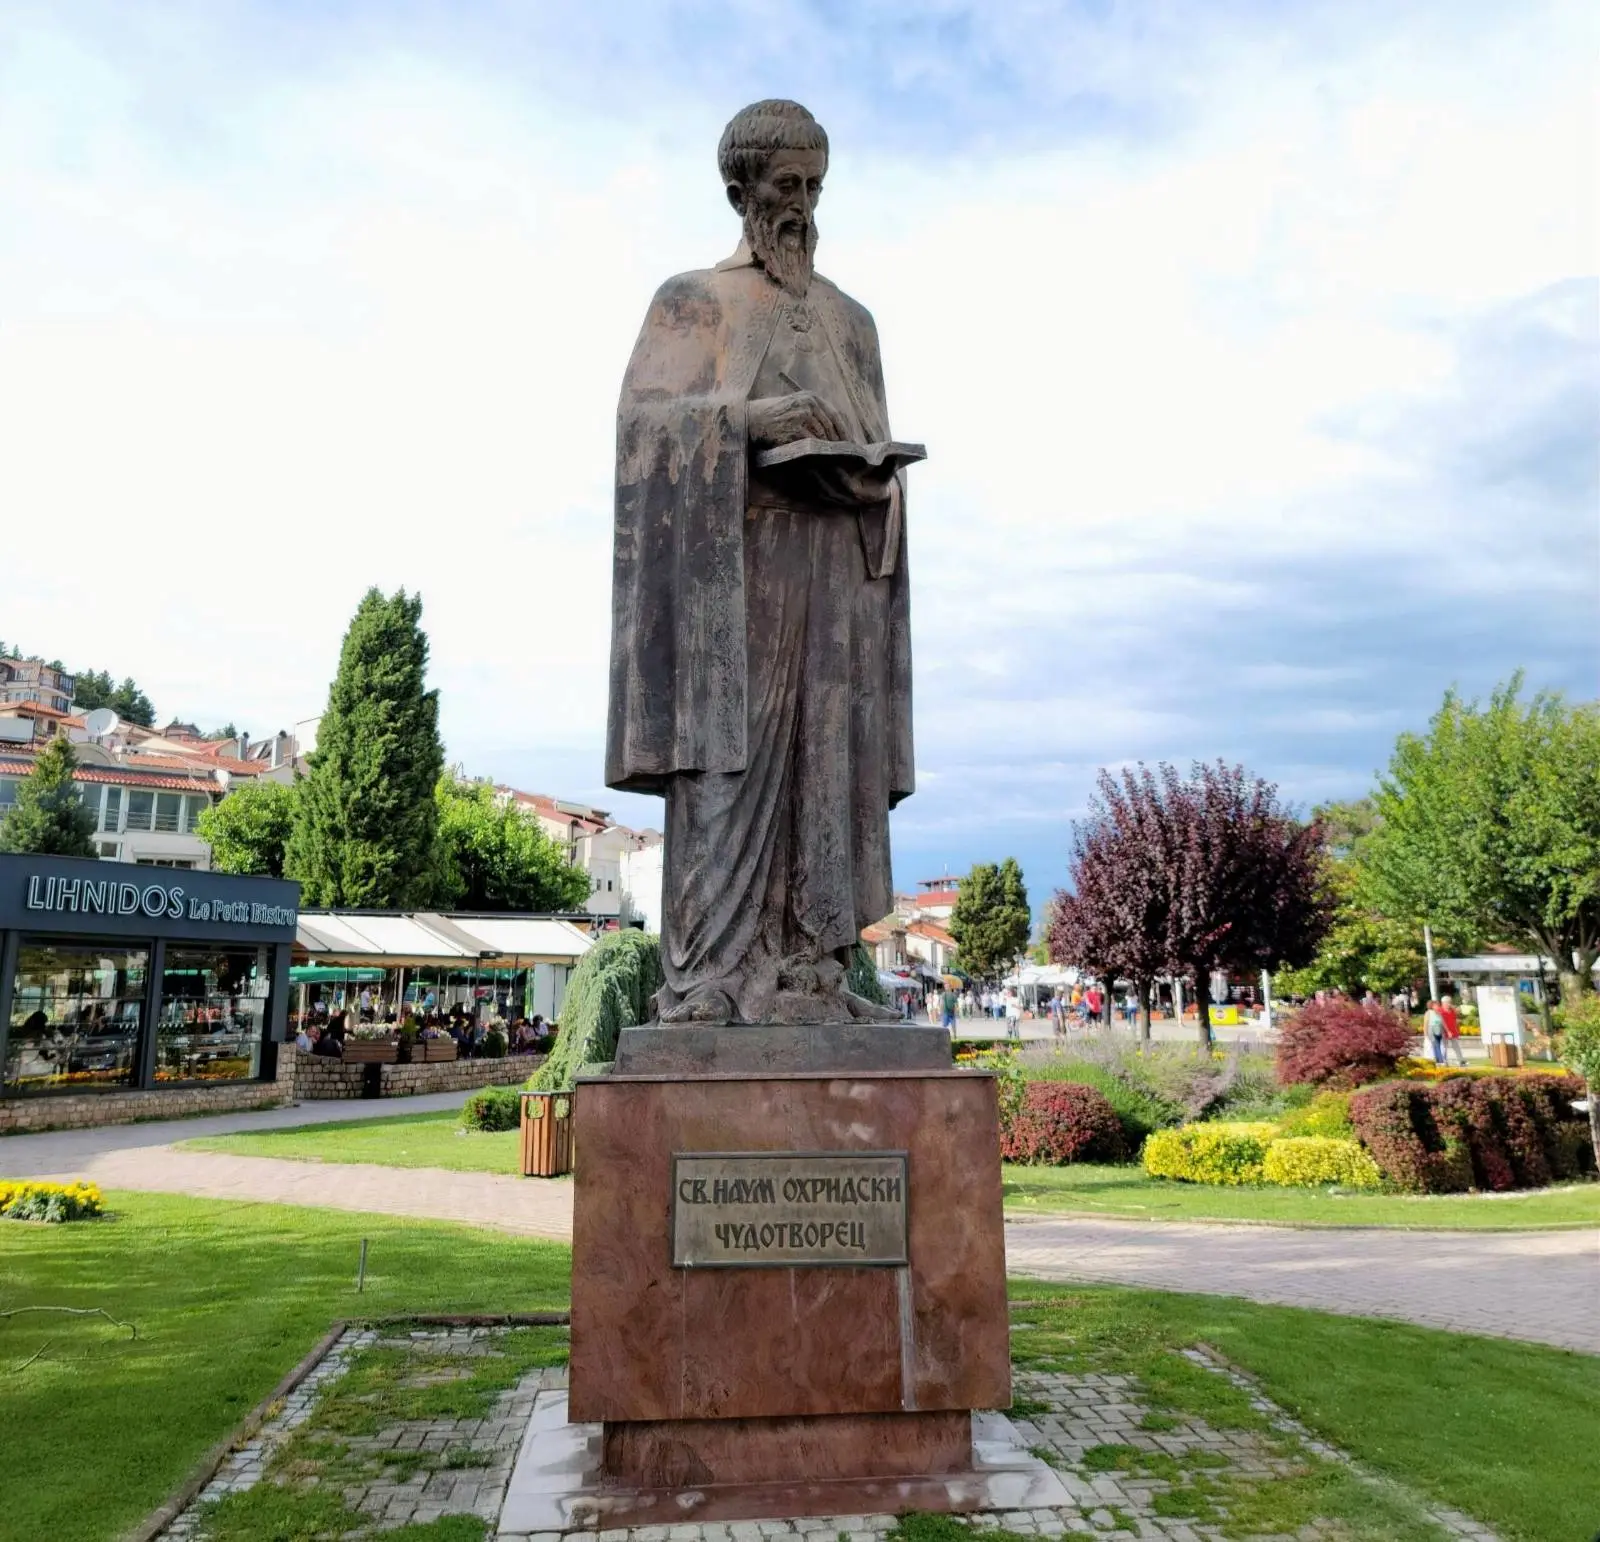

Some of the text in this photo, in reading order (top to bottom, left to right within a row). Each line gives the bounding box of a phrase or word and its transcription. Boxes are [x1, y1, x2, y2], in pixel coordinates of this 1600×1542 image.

[27, 875, 296, 927] LIHNIDOS Le Petit Bistro
[783, 1177, 900, 1205] ОХРИДСКИ
[715, 1222, 866, 1250] ЧУДОТВОРЕЦ
